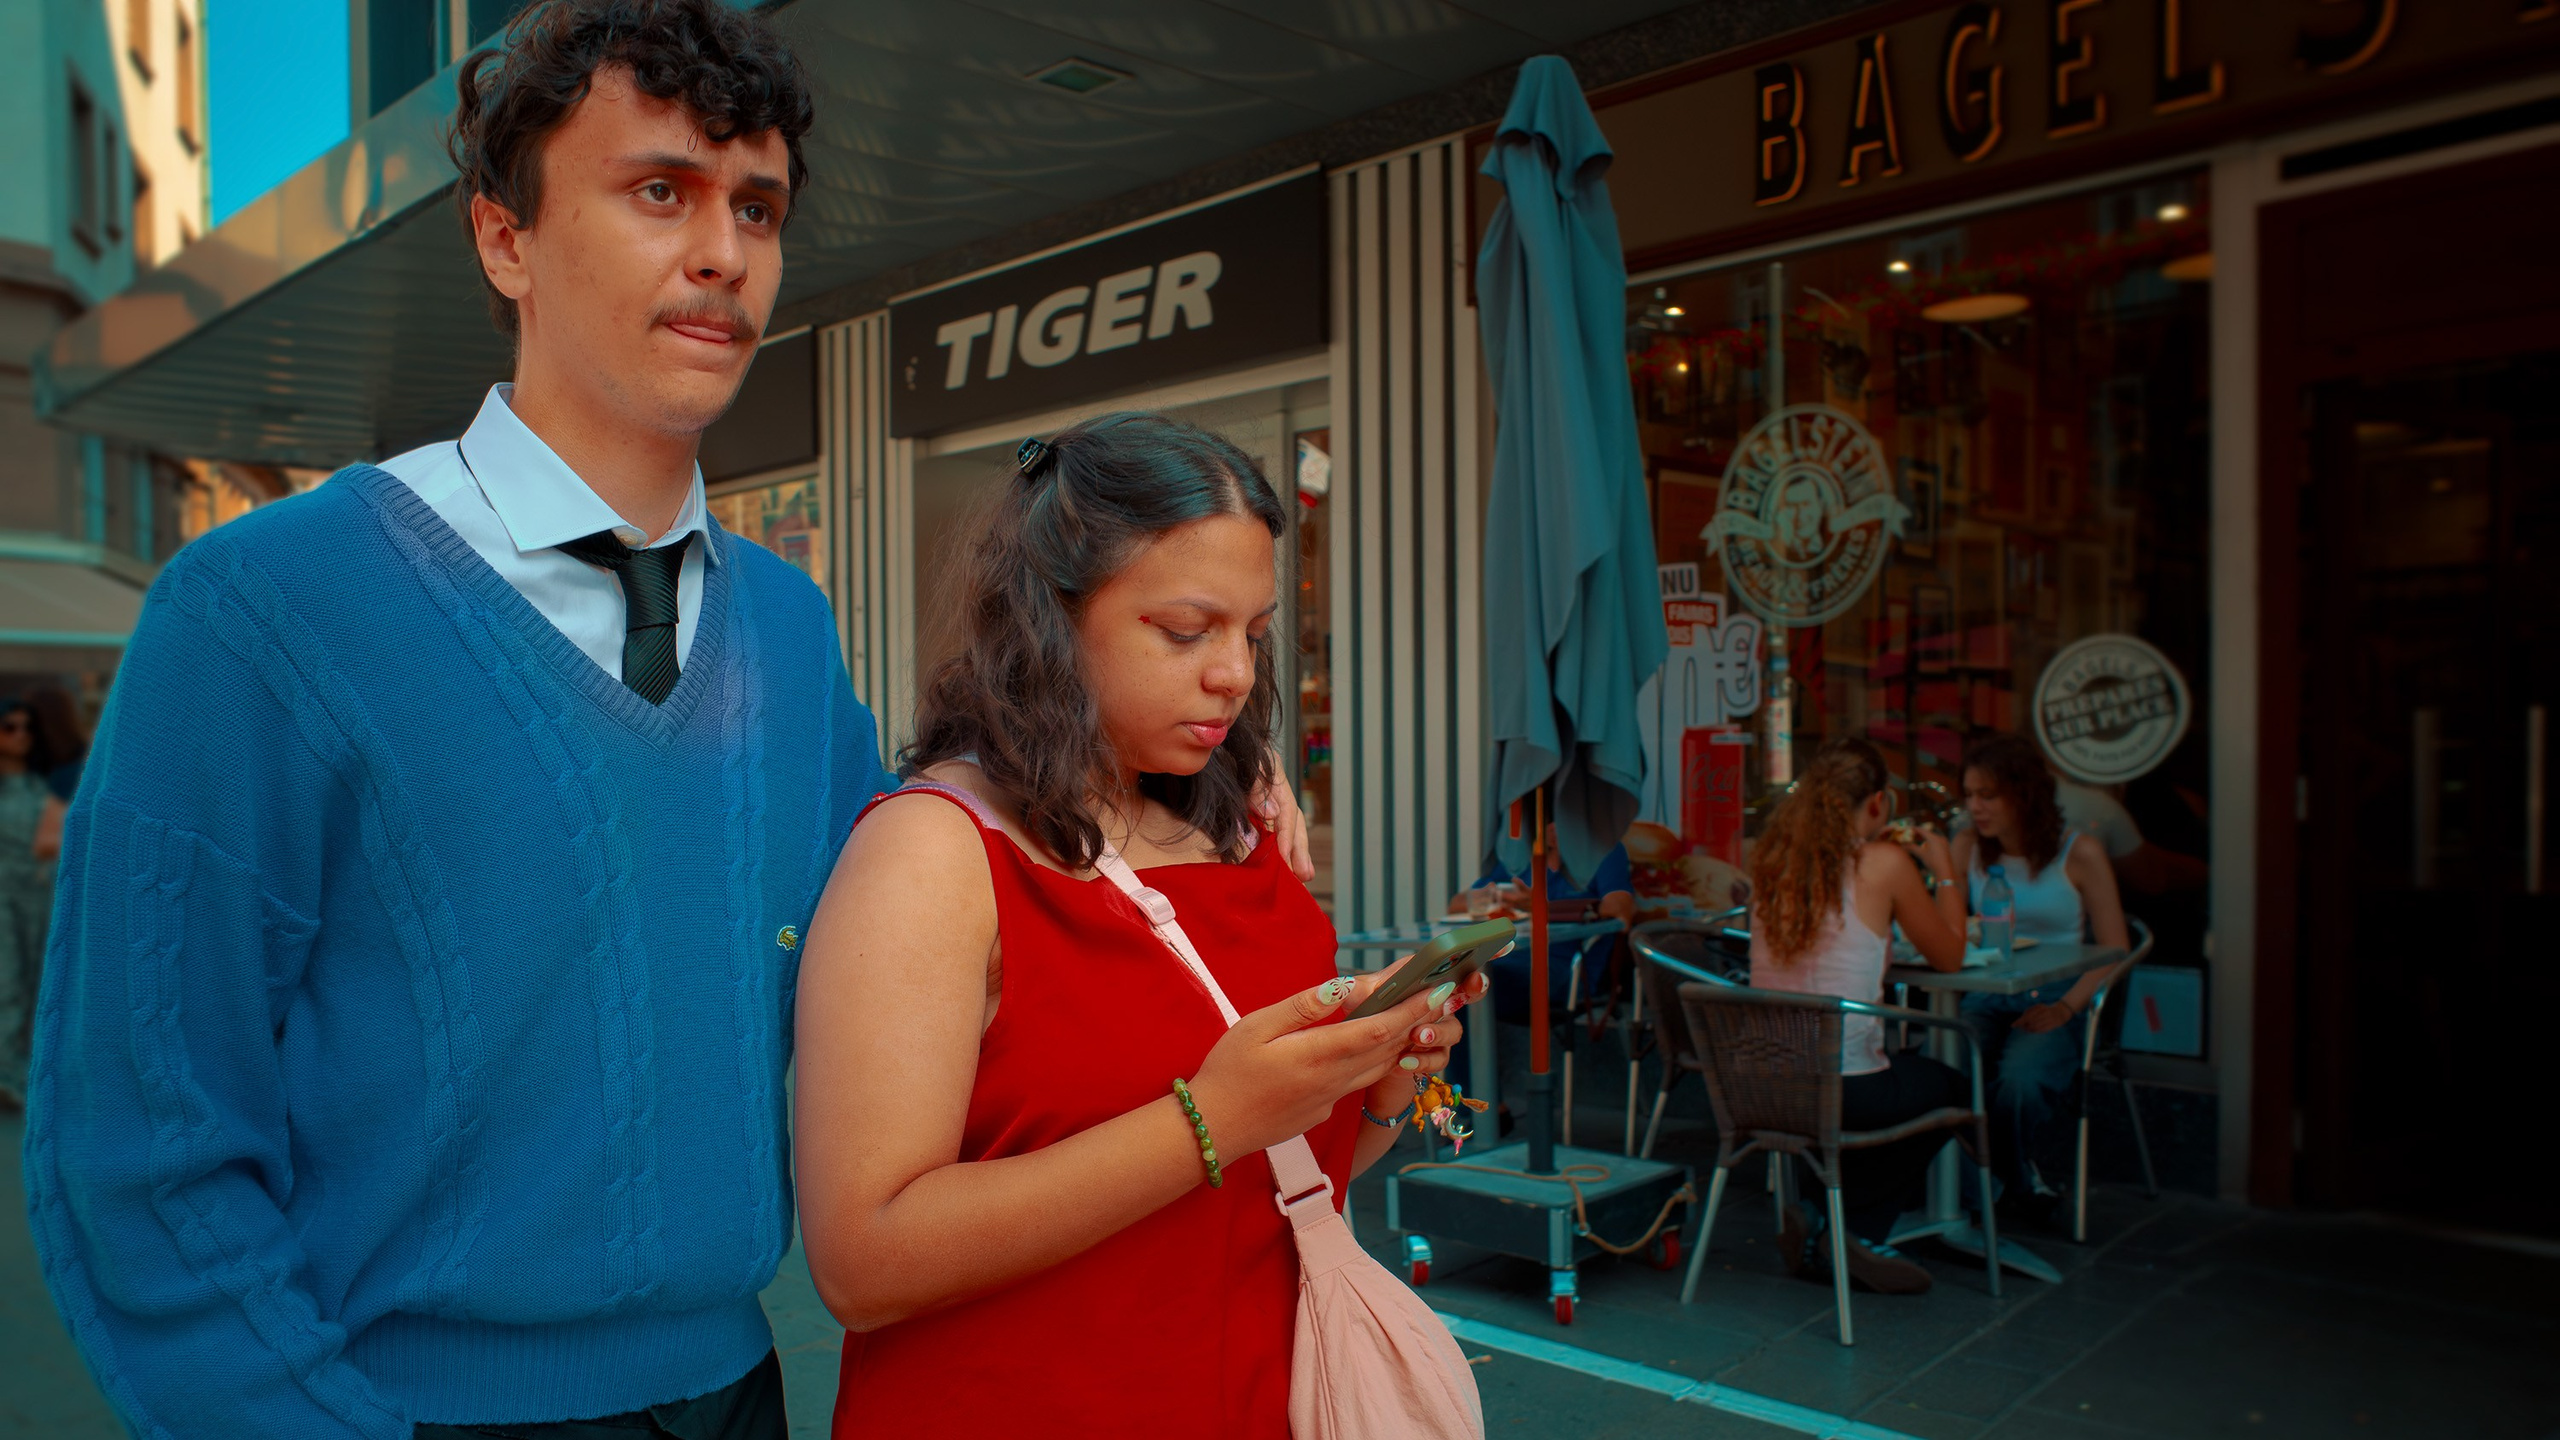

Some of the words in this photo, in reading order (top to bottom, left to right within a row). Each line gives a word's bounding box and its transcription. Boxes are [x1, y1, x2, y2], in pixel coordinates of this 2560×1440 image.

[936, 250, 1223, 391] TIGER
[1726, 413, 1882, 516] BAGELSTEIN
[1782, 571, 1809, 604] &
[2048, 714, 2095, 743] SUR
[2096, 694, 2173, 730] PLACE
[1683, 752, 1740, 806] Coca
